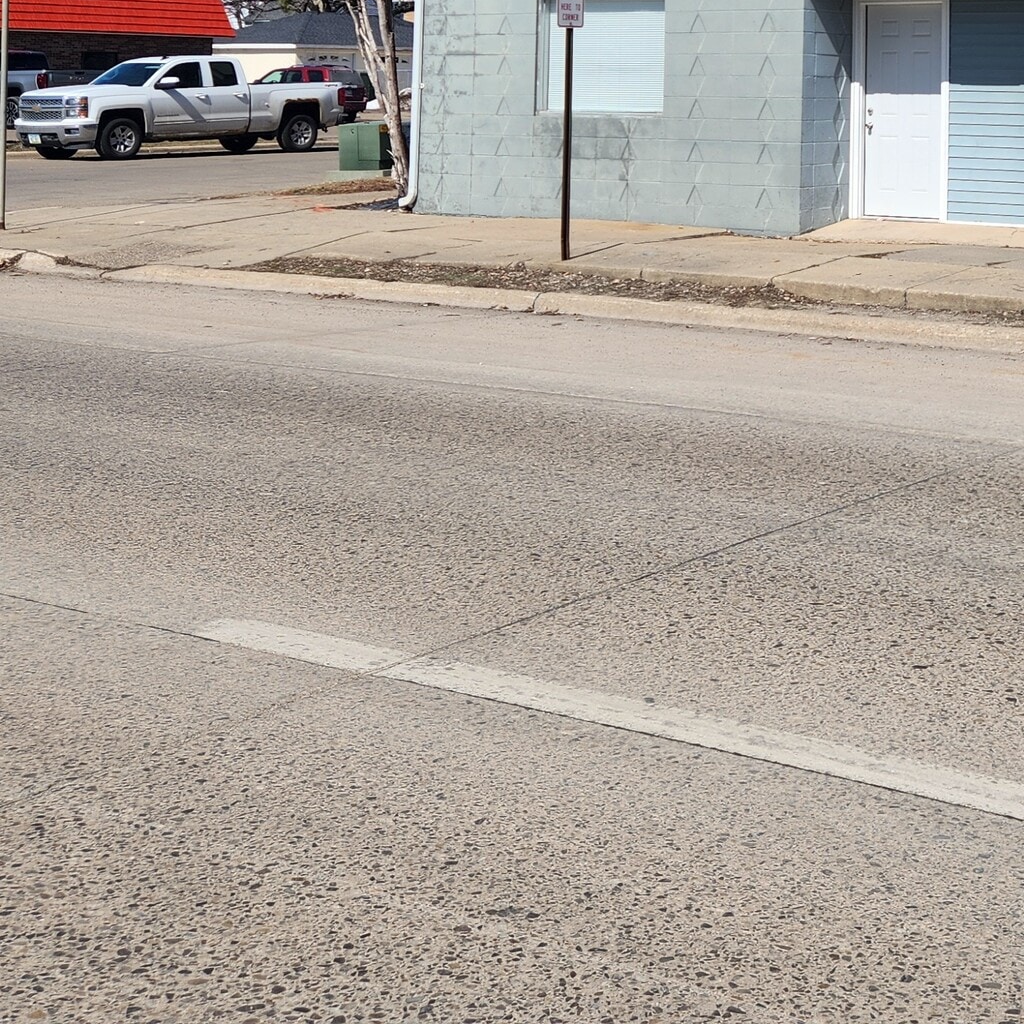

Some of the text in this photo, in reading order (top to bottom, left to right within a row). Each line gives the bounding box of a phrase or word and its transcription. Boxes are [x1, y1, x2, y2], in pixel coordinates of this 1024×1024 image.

[561, 3, 581, 12] HERE TO
[561, 13, 579, 21] CORNER
